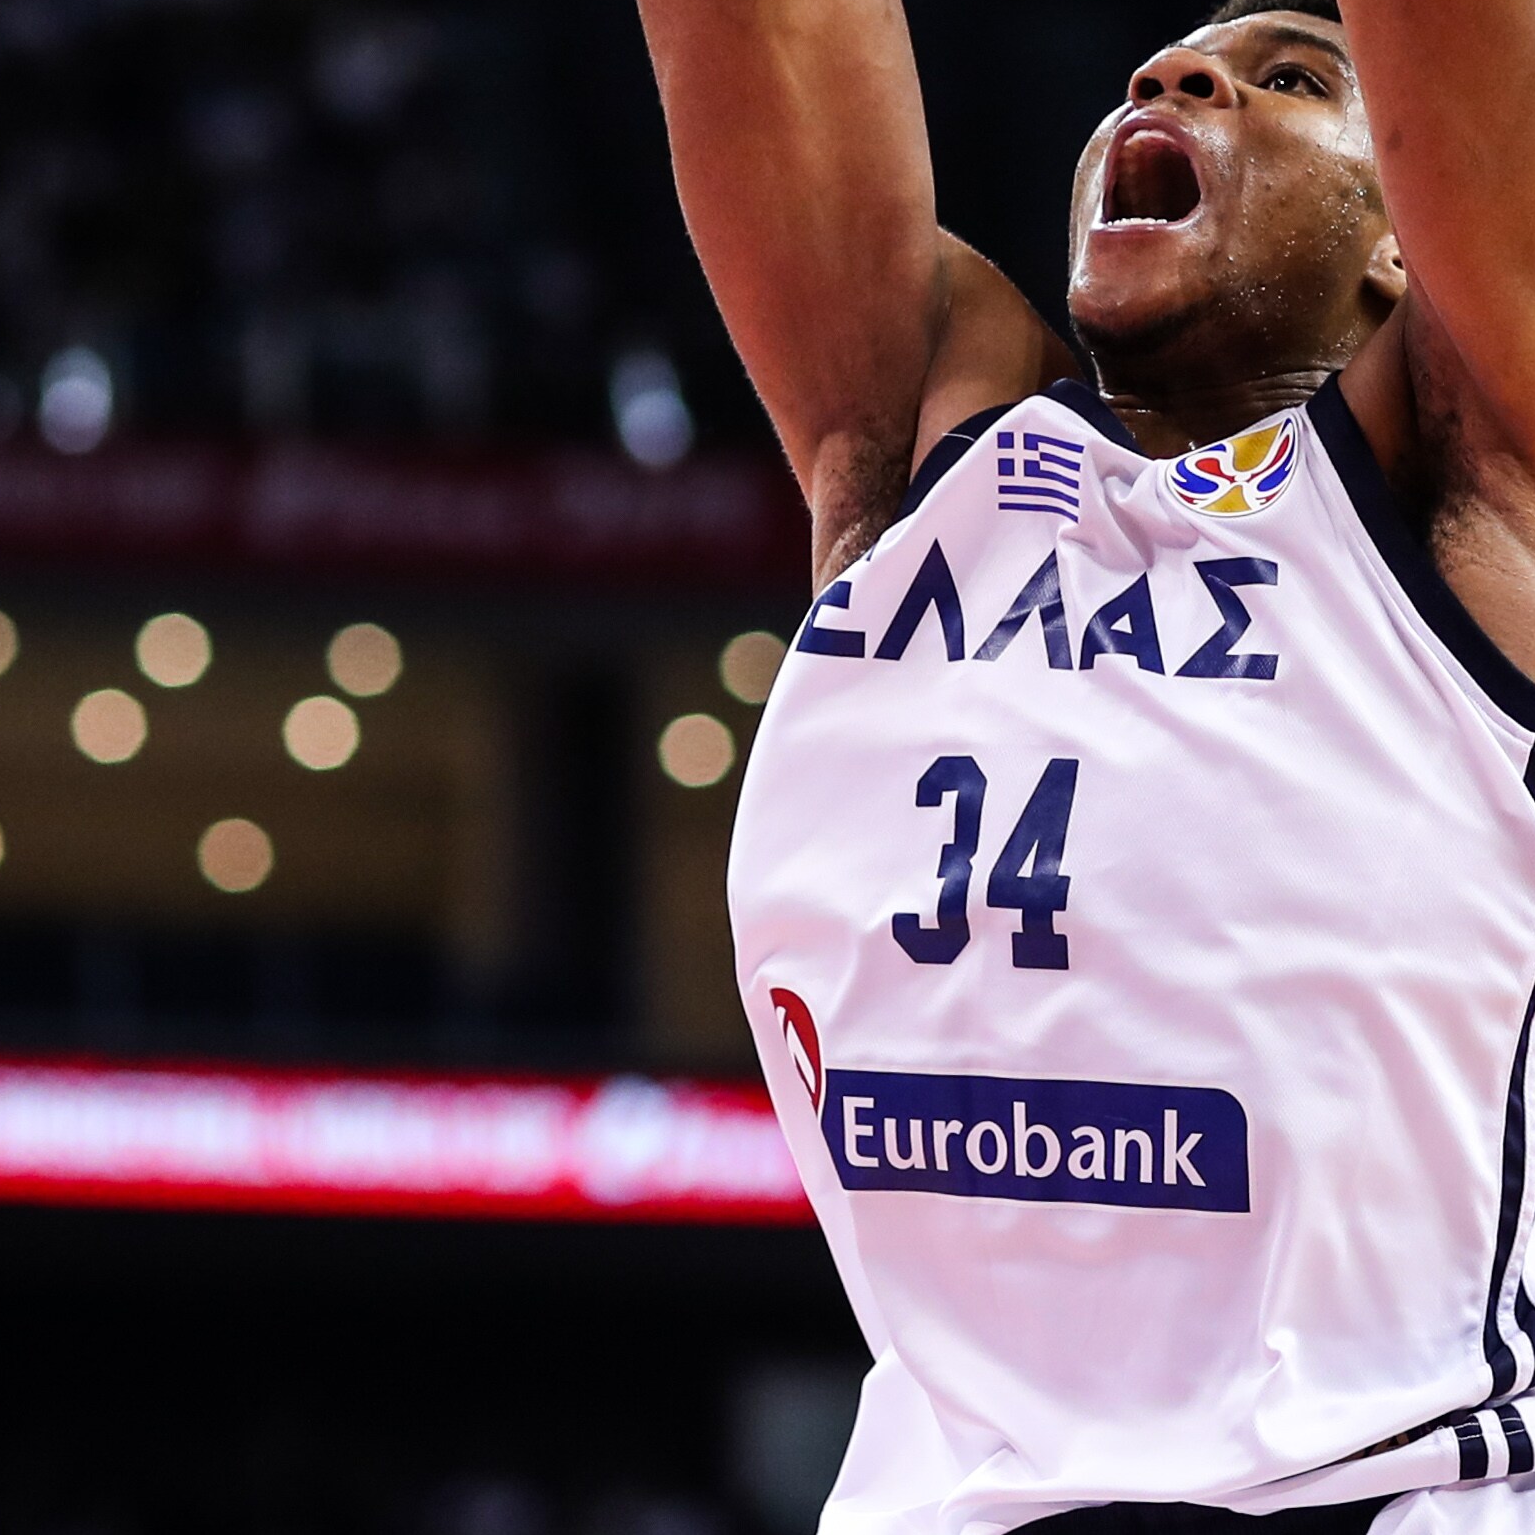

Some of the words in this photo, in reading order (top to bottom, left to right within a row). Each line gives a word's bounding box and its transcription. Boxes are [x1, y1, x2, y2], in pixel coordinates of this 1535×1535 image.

[795, 537, 1279, 681] ΕΛΛΑΣ
[892, 755, 1080, 971] 34
[842, 1095, 1207, 1188] Eurobank
